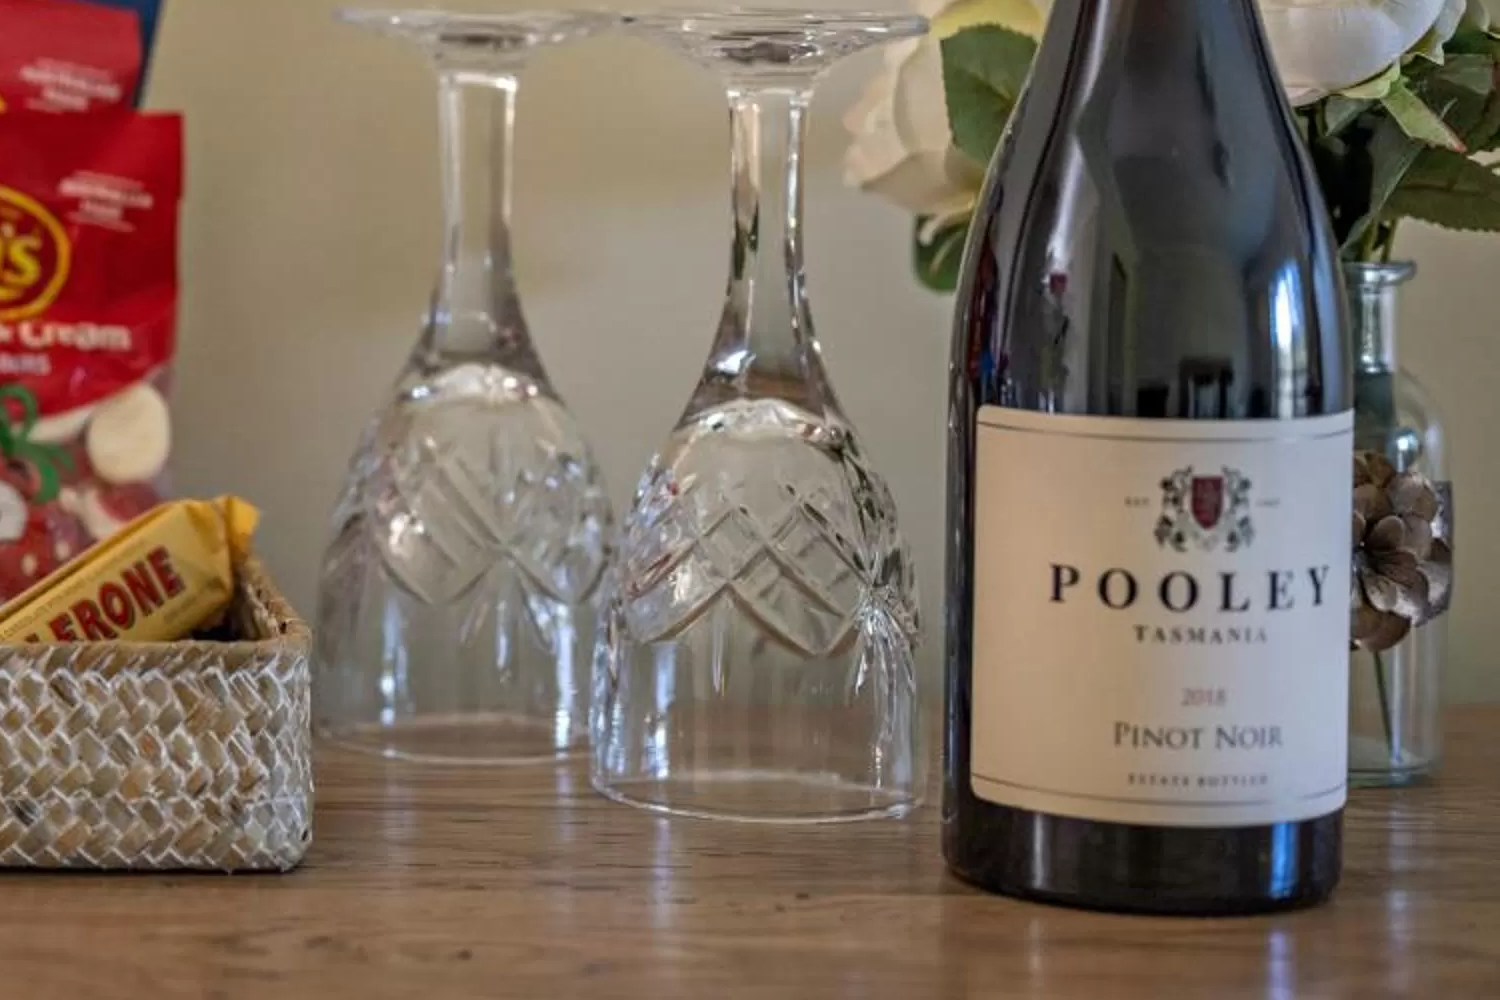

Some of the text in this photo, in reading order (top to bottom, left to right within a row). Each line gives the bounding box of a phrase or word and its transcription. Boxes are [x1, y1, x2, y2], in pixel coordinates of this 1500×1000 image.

[1049, 563, 1331, 613] POOLEY
[1132, 624, 1269, 645] TASMANIA
[1181, 687, 1227, 708] 2018
[1113, 720, 1284, 750] PINOT NOIR
